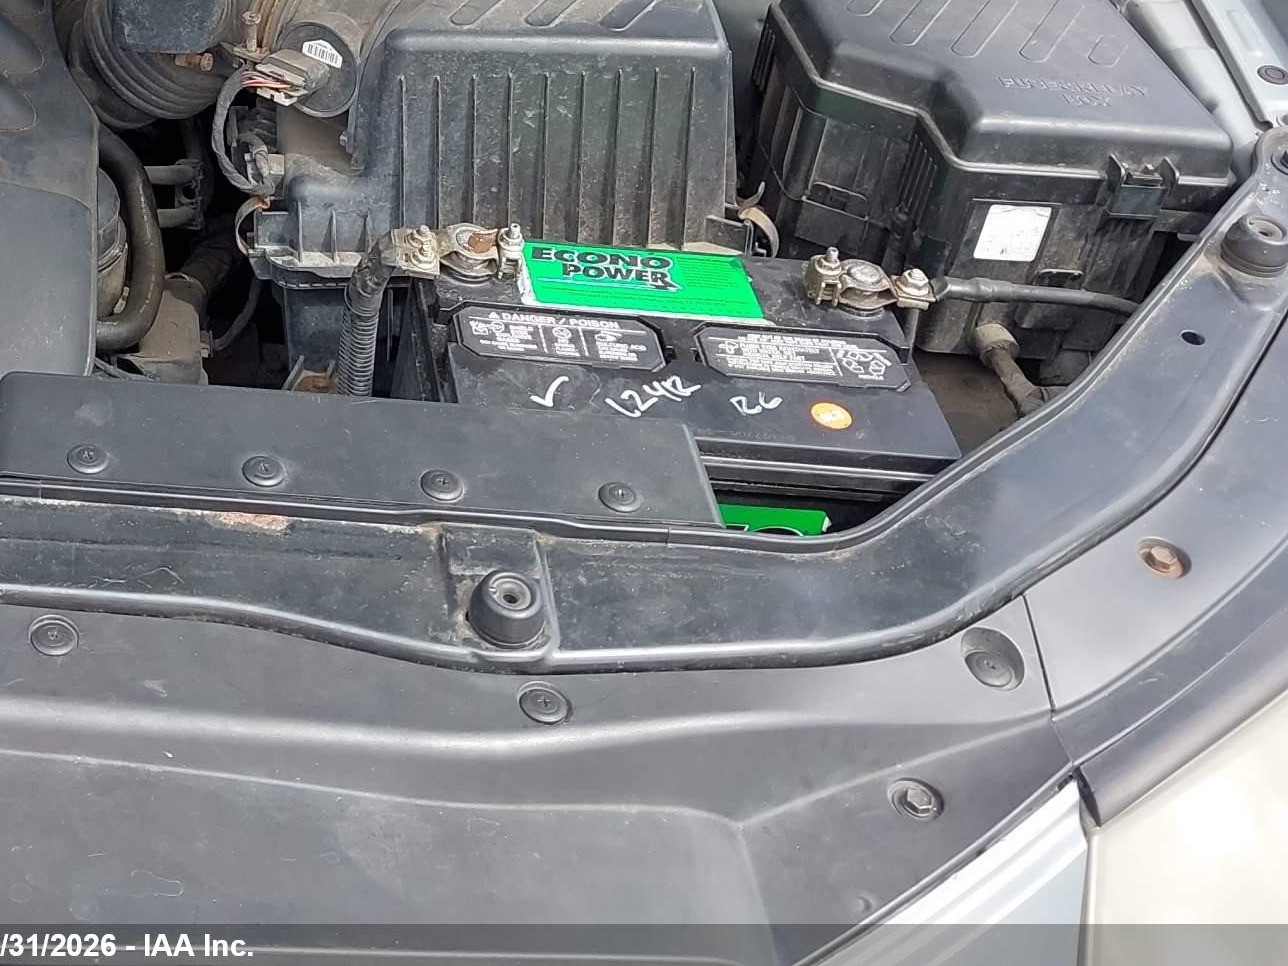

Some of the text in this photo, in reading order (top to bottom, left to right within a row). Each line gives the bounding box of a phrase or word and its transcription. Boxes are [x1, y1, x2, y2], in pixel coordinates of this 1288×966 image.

[531, 246, 674, 270] ECONO
[562, 262, 673, 286] POWER
[501, 312, 556, 325] DANGER
[568, 318, 620, 329] POISON
